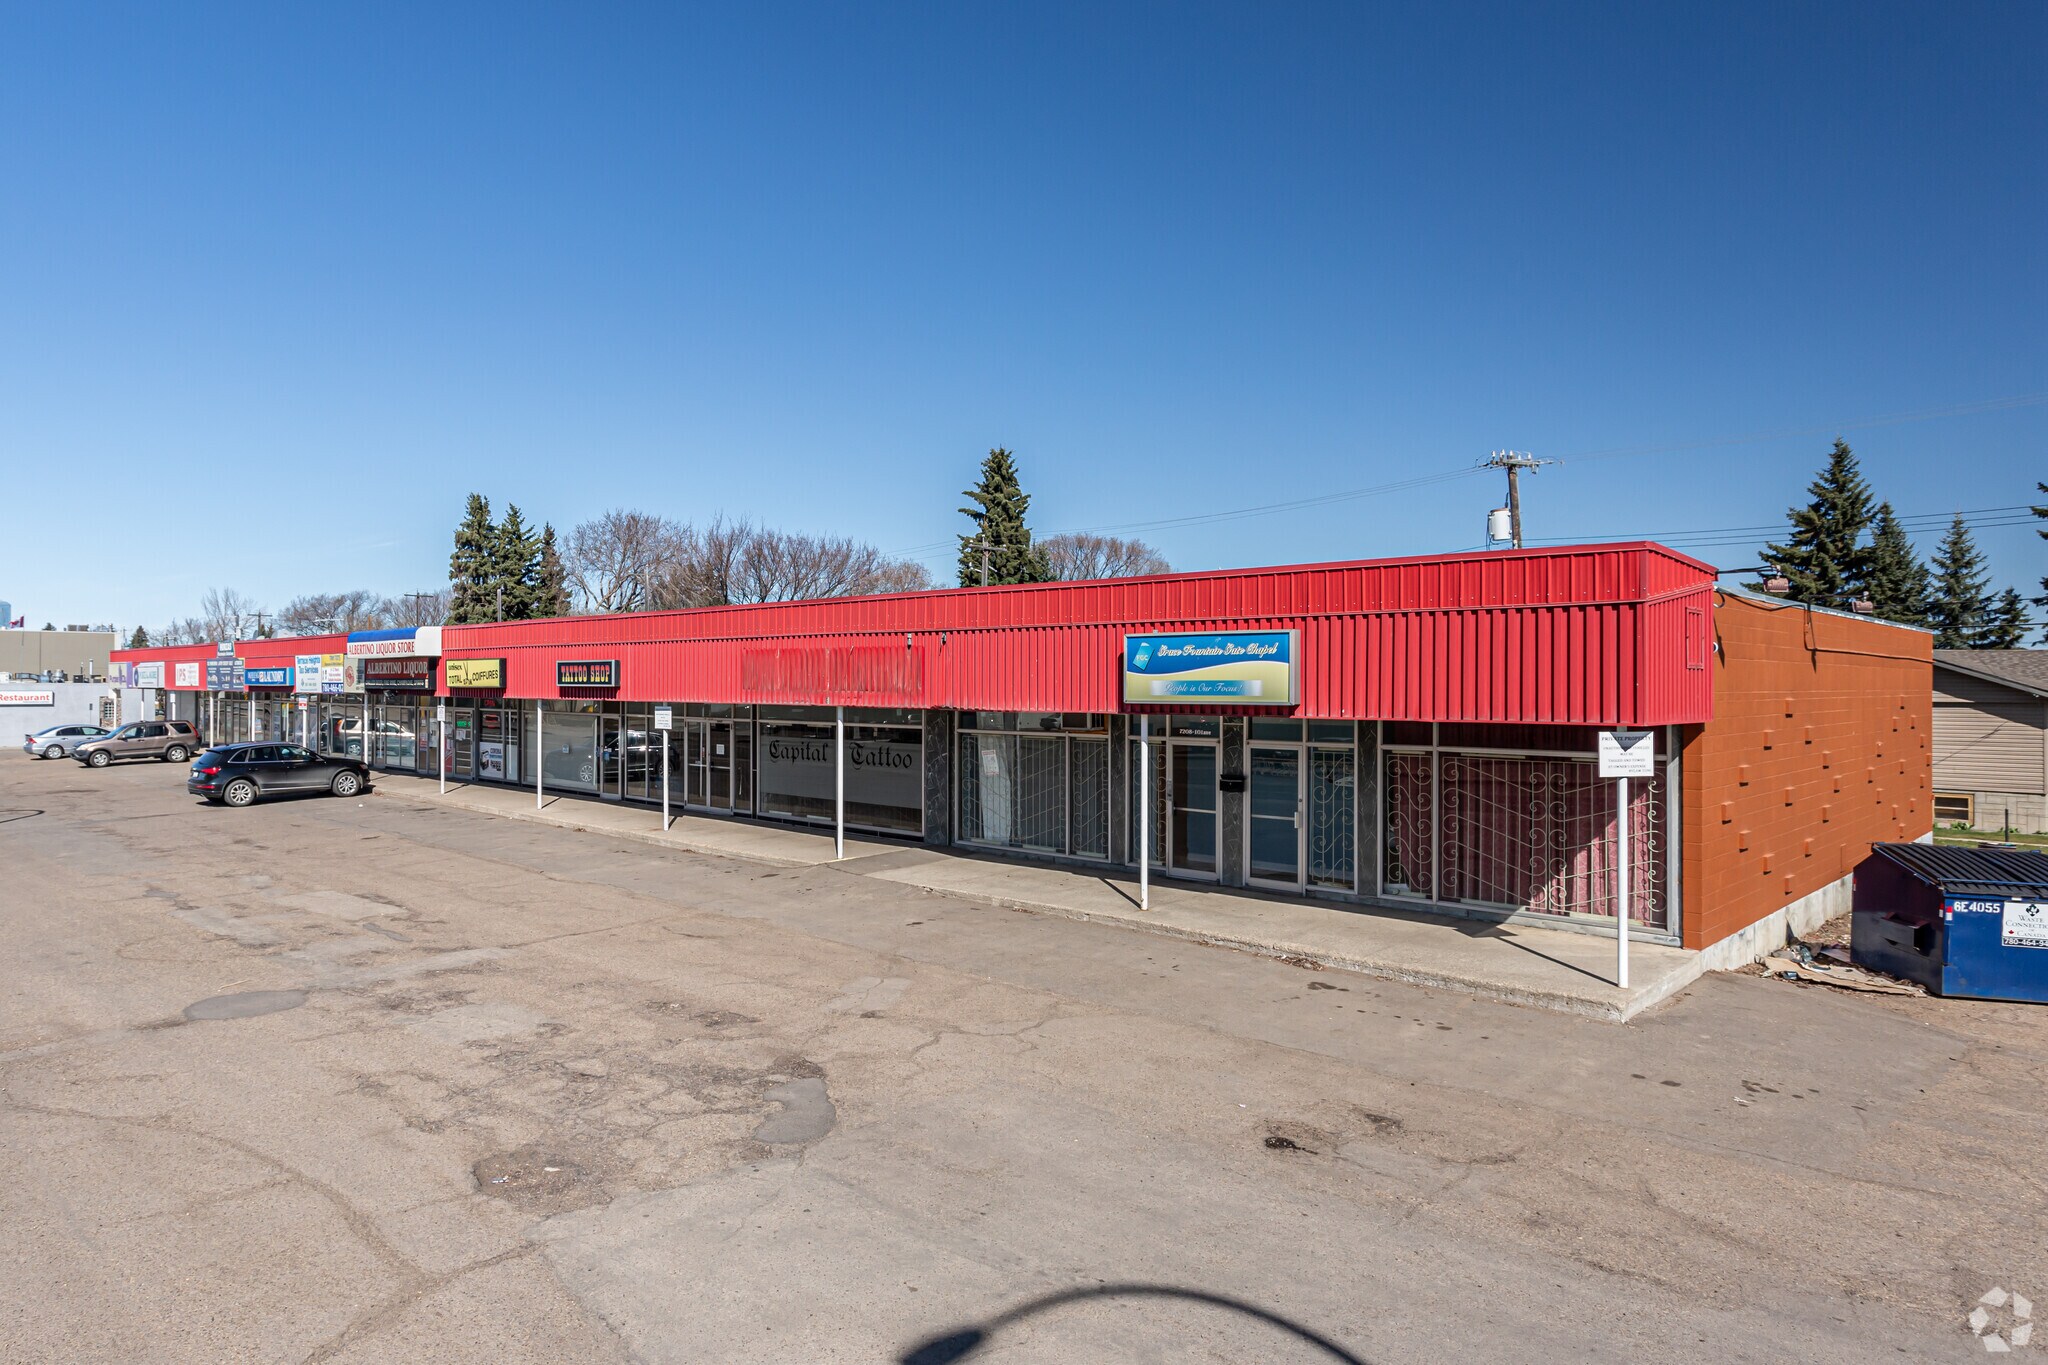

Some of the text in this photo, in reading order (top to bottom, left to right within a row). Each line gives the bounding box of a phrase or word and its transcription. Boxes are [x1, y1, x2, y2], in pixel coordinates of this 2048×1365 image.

[349, 641, 415, 656] ALBERTINO LIQUOR STORE
[1181, 644, 1223, 656] Fountain
[1223, 643, 1245, 655] Gate
[1246, 642, 1279, 658] Chapel
[366, 662, 402, 674] ALBERTINO
[403, 661, 428, 678] LIQUOR
[472, 669, 499, 681] COIFFURES
[561, 664, 611, 682] TATTOO SHOP
[1165, 682, 1188, 695] People
[1190, 683, 1197, 692] is
[1199, 682, 1213, 692] Our
[768, 739, 913, 770] Capital Tattoo
[2018, 914, 2044, 923] WASTE
